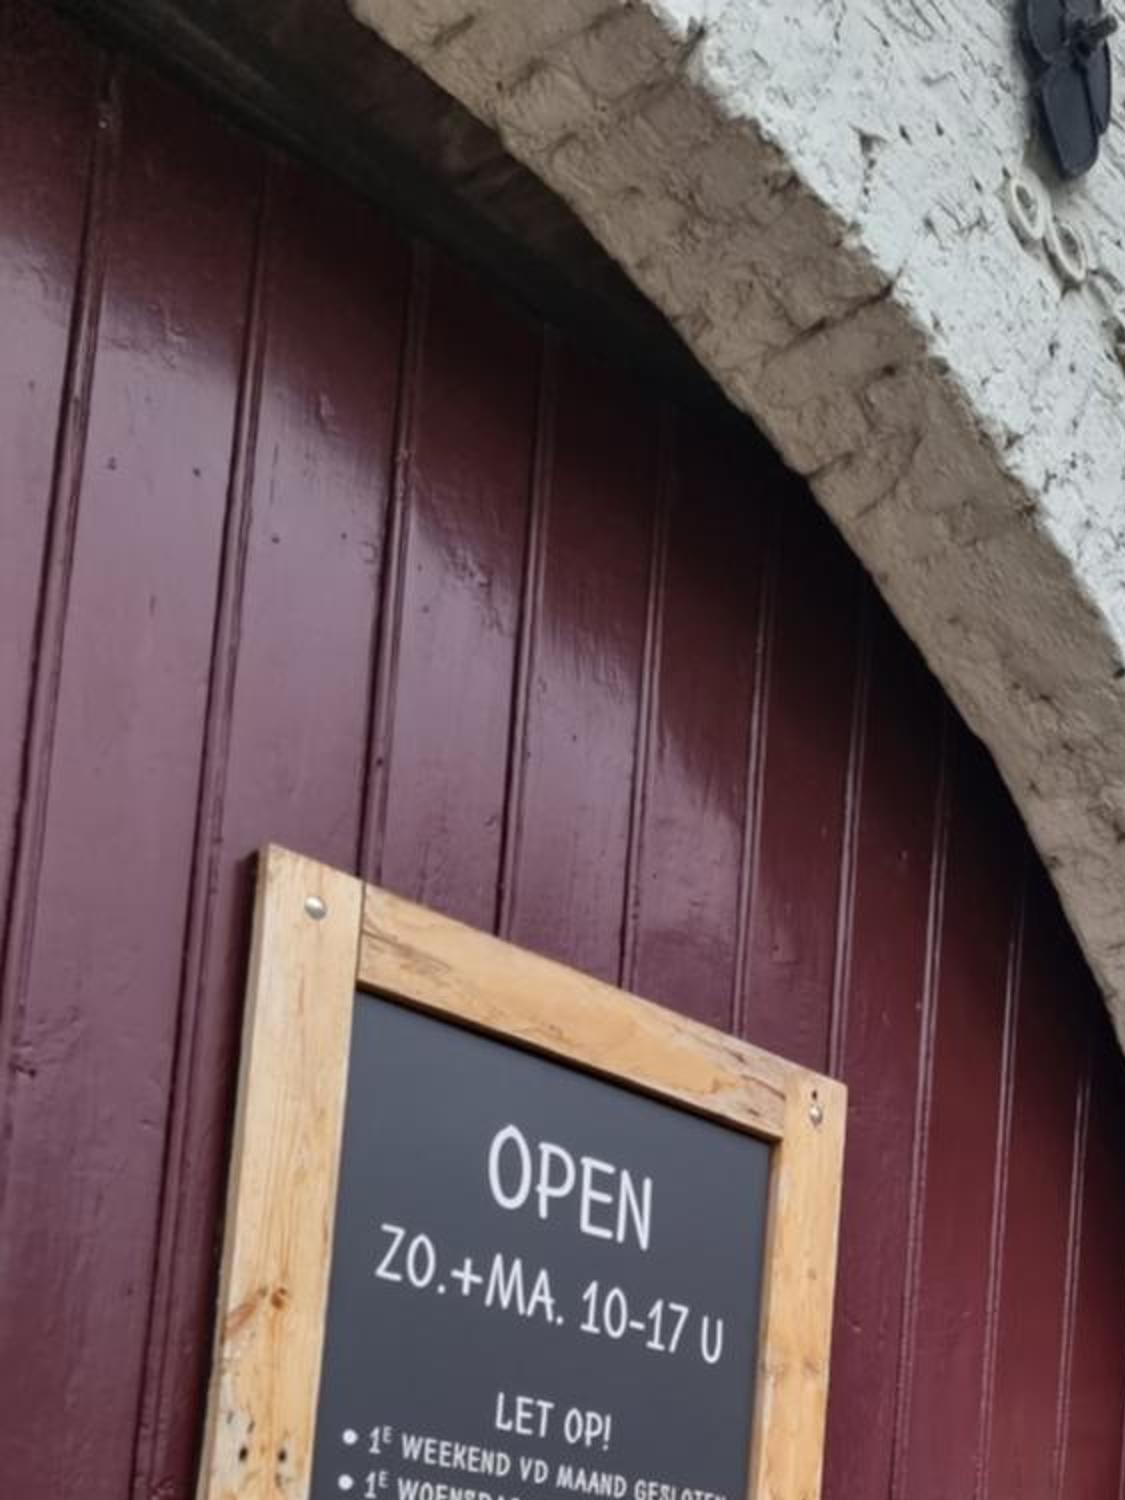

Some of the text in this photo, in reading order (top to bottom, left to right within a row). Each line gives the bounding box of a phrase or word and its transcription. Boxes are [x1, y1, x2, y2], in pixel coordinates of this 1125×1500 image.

[488, 1124, 653, 1252] OPEN
[374, 1223, 724, 1364] ZO.+MA. 10-17 U
[401, 1432, 511, 1477] WEEKEND
[519, 1456, 549, 1484] VD
[556, 1464, 627, 1499] MAAND
[494, 1393, 613, 1452] LET OP!
